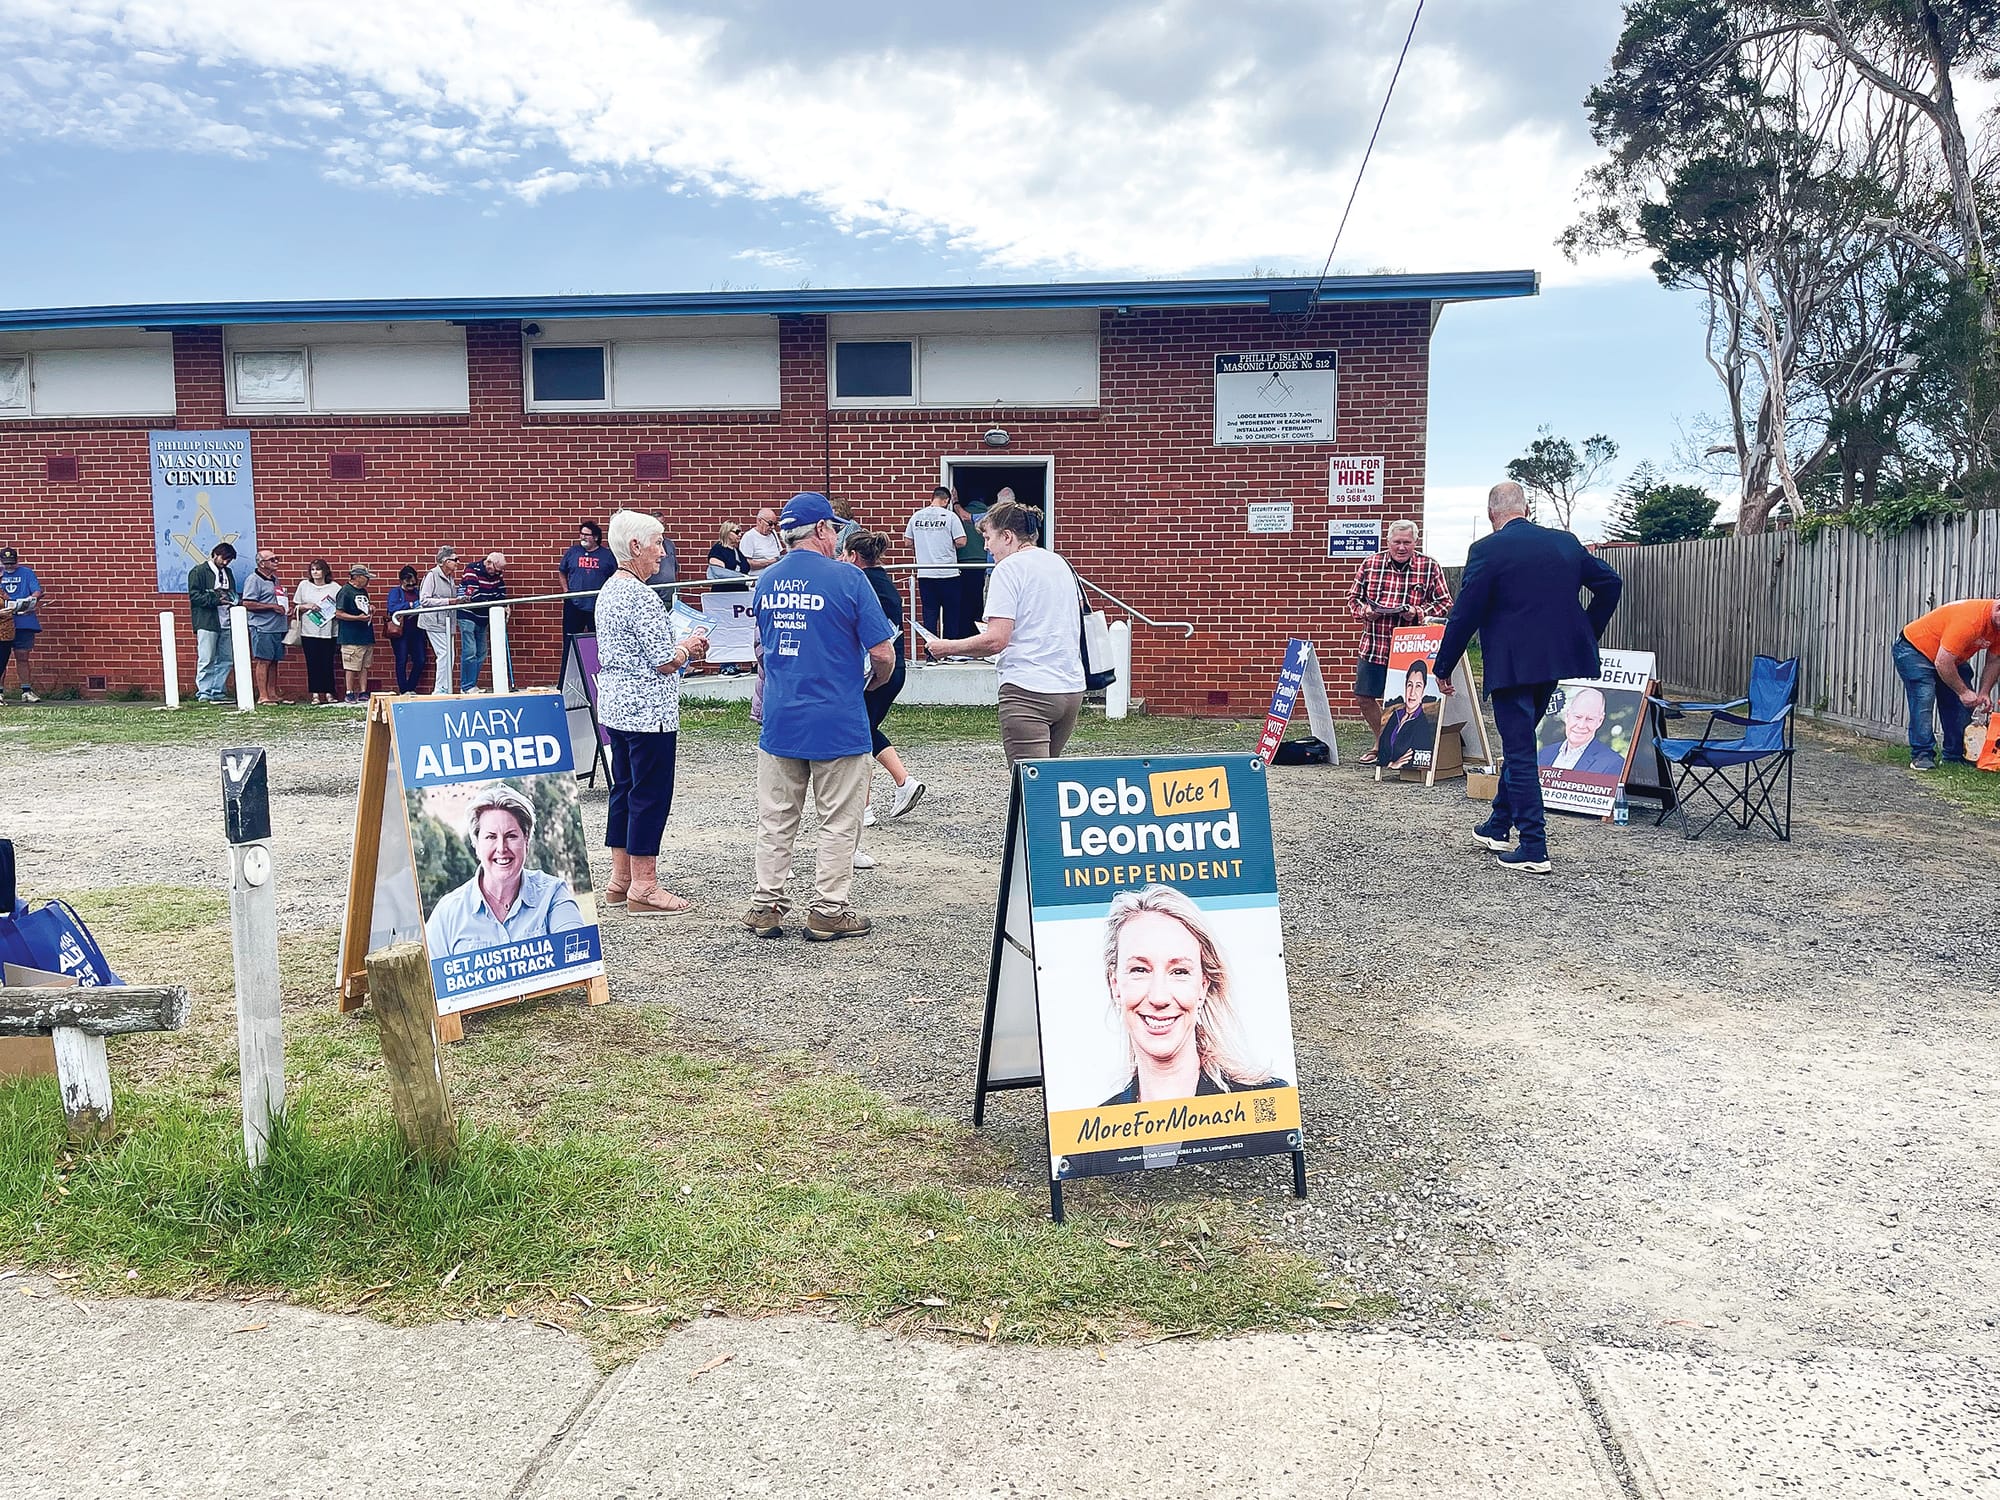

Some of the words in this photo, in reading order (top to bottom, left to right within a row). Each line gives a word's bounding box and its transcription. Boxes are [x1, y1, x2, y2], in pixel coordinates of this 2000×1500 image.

[1240, 354, 1276, 362] PHILLIP
[1278, 352, 1313, 362] ISLAND
[1223, 363, 1264, 372] MASONIC
[1268, 361, 1298, 370] LODGE
[1316, 360, 1330, 368] 512
[156, 442, 200, 451] PHILLIP
[203, 441, 244, 450] ISLAND
[158, 453, 242, 468] MASONIC
[1334, 460, 1357, 469] HALL
[1361, 459, 1380, 469] FOR
[165, 470, 238, 486] CENTRE
[1338, 470, 1374, 485] HIRE
[1336, 494, 1345, 502] 59
[774, 580, 809, 591] MARY
[761, 593, 824, 610] ALDRED
[773, 612, 794, 620] Liberal
[774, 621, 806, 630] MONASH
[1277, 682, 1296, 700] Family
[1274, 700, 1289, 714] First
[443, 708, 524, 739] MARY
[1268, 719, 1284, 735] VOTE
[1262, 734, 1278, 749] Family
[415, 735, 561, 780] ALDRED
[1414, 752, 1431, 761] one
[1542, 770, 1563, 779] TRUE
[1162, 781, 1204, 807] Vote
[1208, 777, 1219, 798] 1
[1552, 781, 1612, 796] INDEPENDENT
[1057, 777, 1147, 818] Deb
[1551, 790, 1568, 800] FOR
[1569, 793, 1609, 806] MONASH
[1060, 812, 1241, 857] Leonard
[1064, 859, 1243, 887] INDEPENDENT
[443, 958, 471, 976] GET
[473, 939, 554, 969] AUSTRALIA
[446, 969, 485, 992] BACK
[487, 965, 506, 982] ON
[509, 954, 556, 977] TRACK
[1077, 1101, 1246, 1144] MoreForMonash
